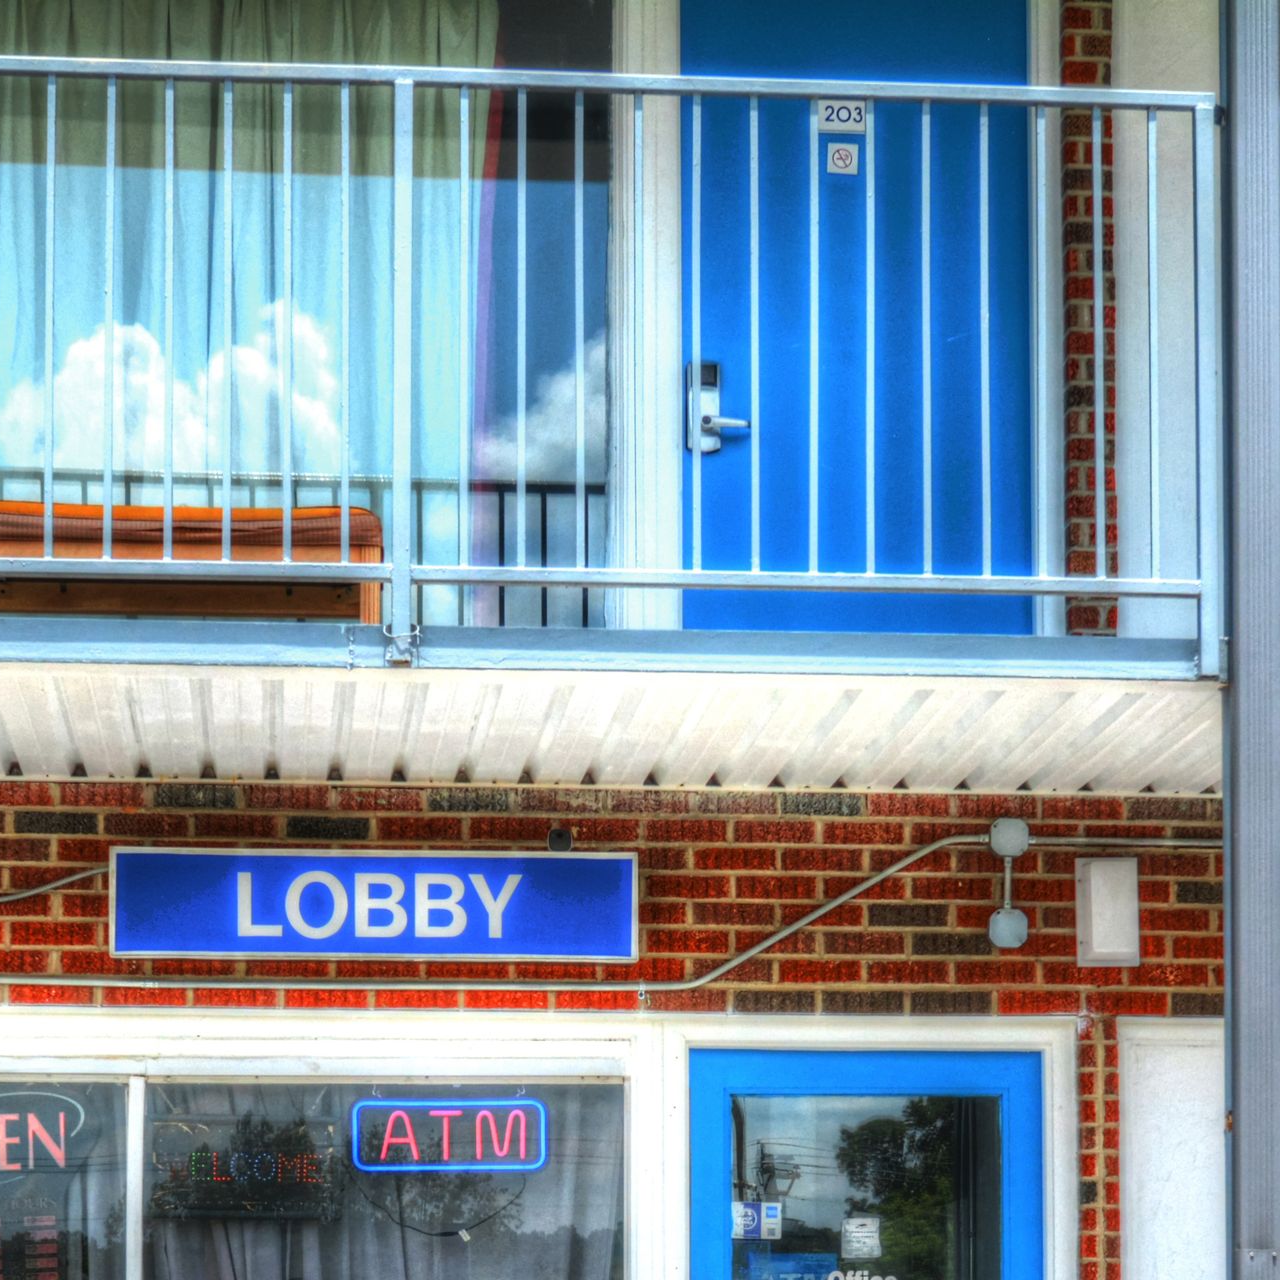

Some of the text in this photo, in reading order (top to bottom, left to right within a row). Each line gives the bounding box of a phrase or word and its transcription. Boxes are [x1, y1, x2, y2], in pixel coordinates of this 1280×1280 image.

[824, 105, 863, 123] 203
[236, 870, 523, 940] LOBBY
[379, 1109, 527, 1161] ATM
[166, 1151, 325, 1184] WELCOME
